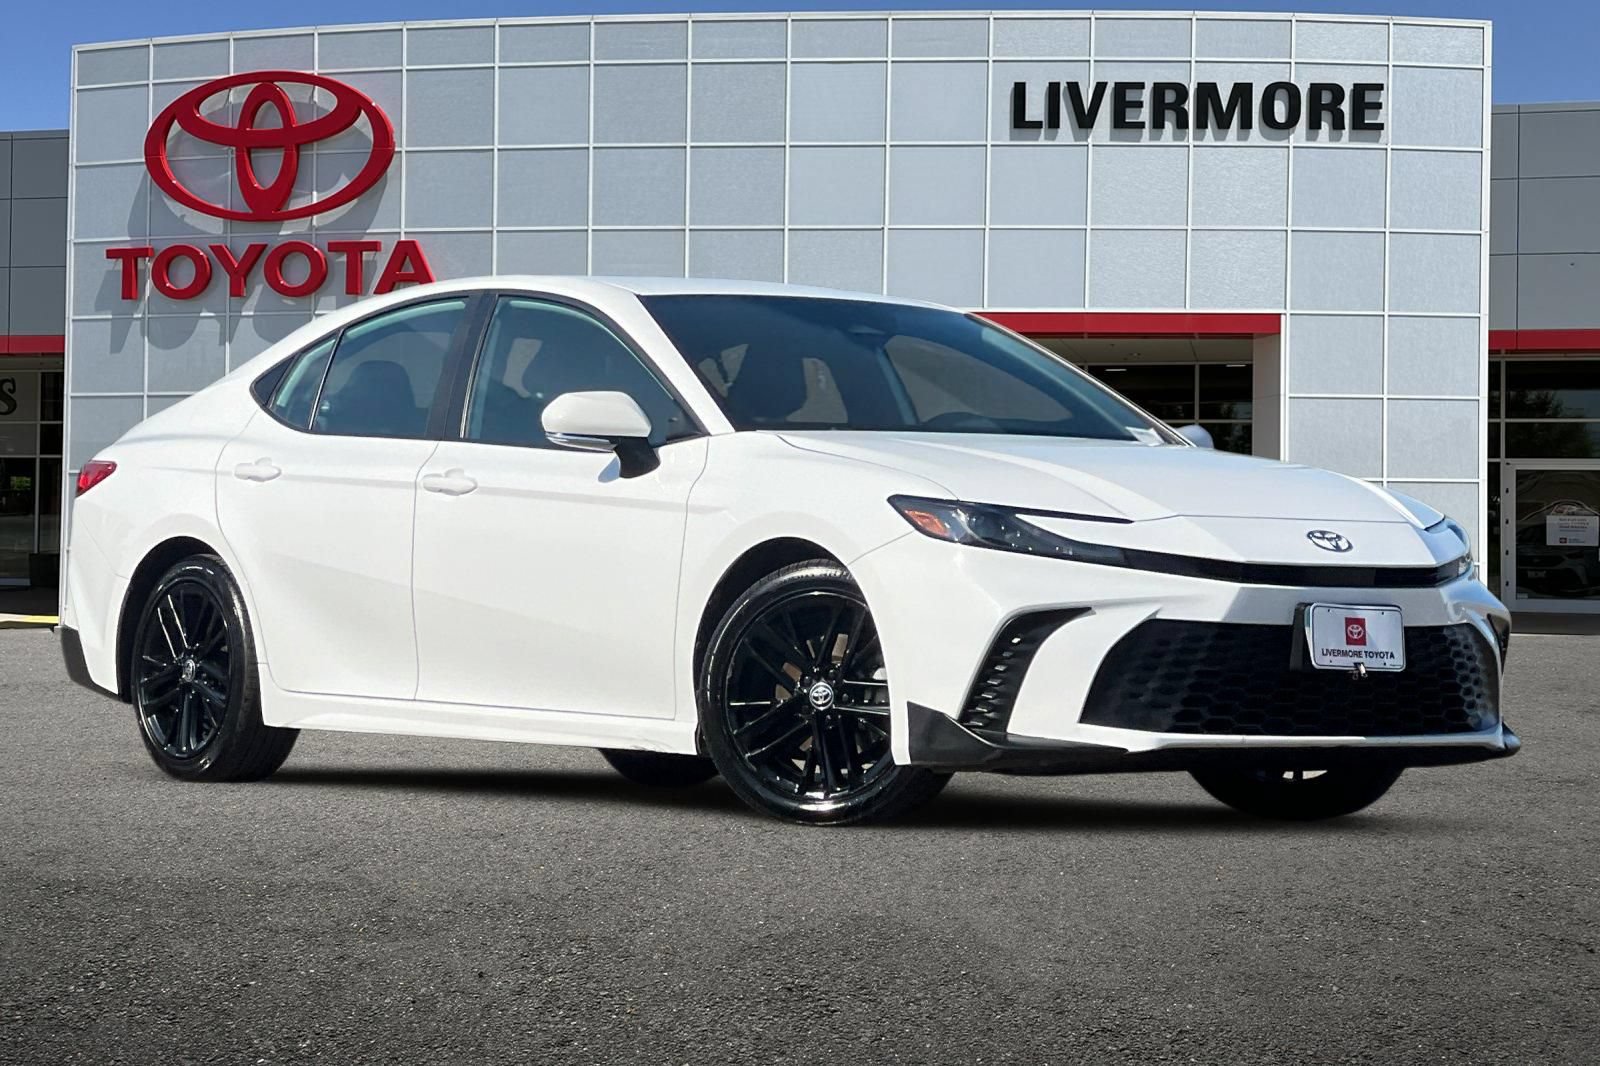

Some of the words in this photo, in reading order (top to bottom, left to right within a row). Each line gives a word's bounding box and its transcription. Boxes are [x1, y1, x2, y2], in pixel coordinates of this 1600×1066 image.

[1013, 81, 1385, 131] LIVERMORE
[105, 239, 436, 300] TOYOTA
[1321, 648, 1362, 659] LIVERMORE
[1364, 650, 1395, 660] TOYOTA
